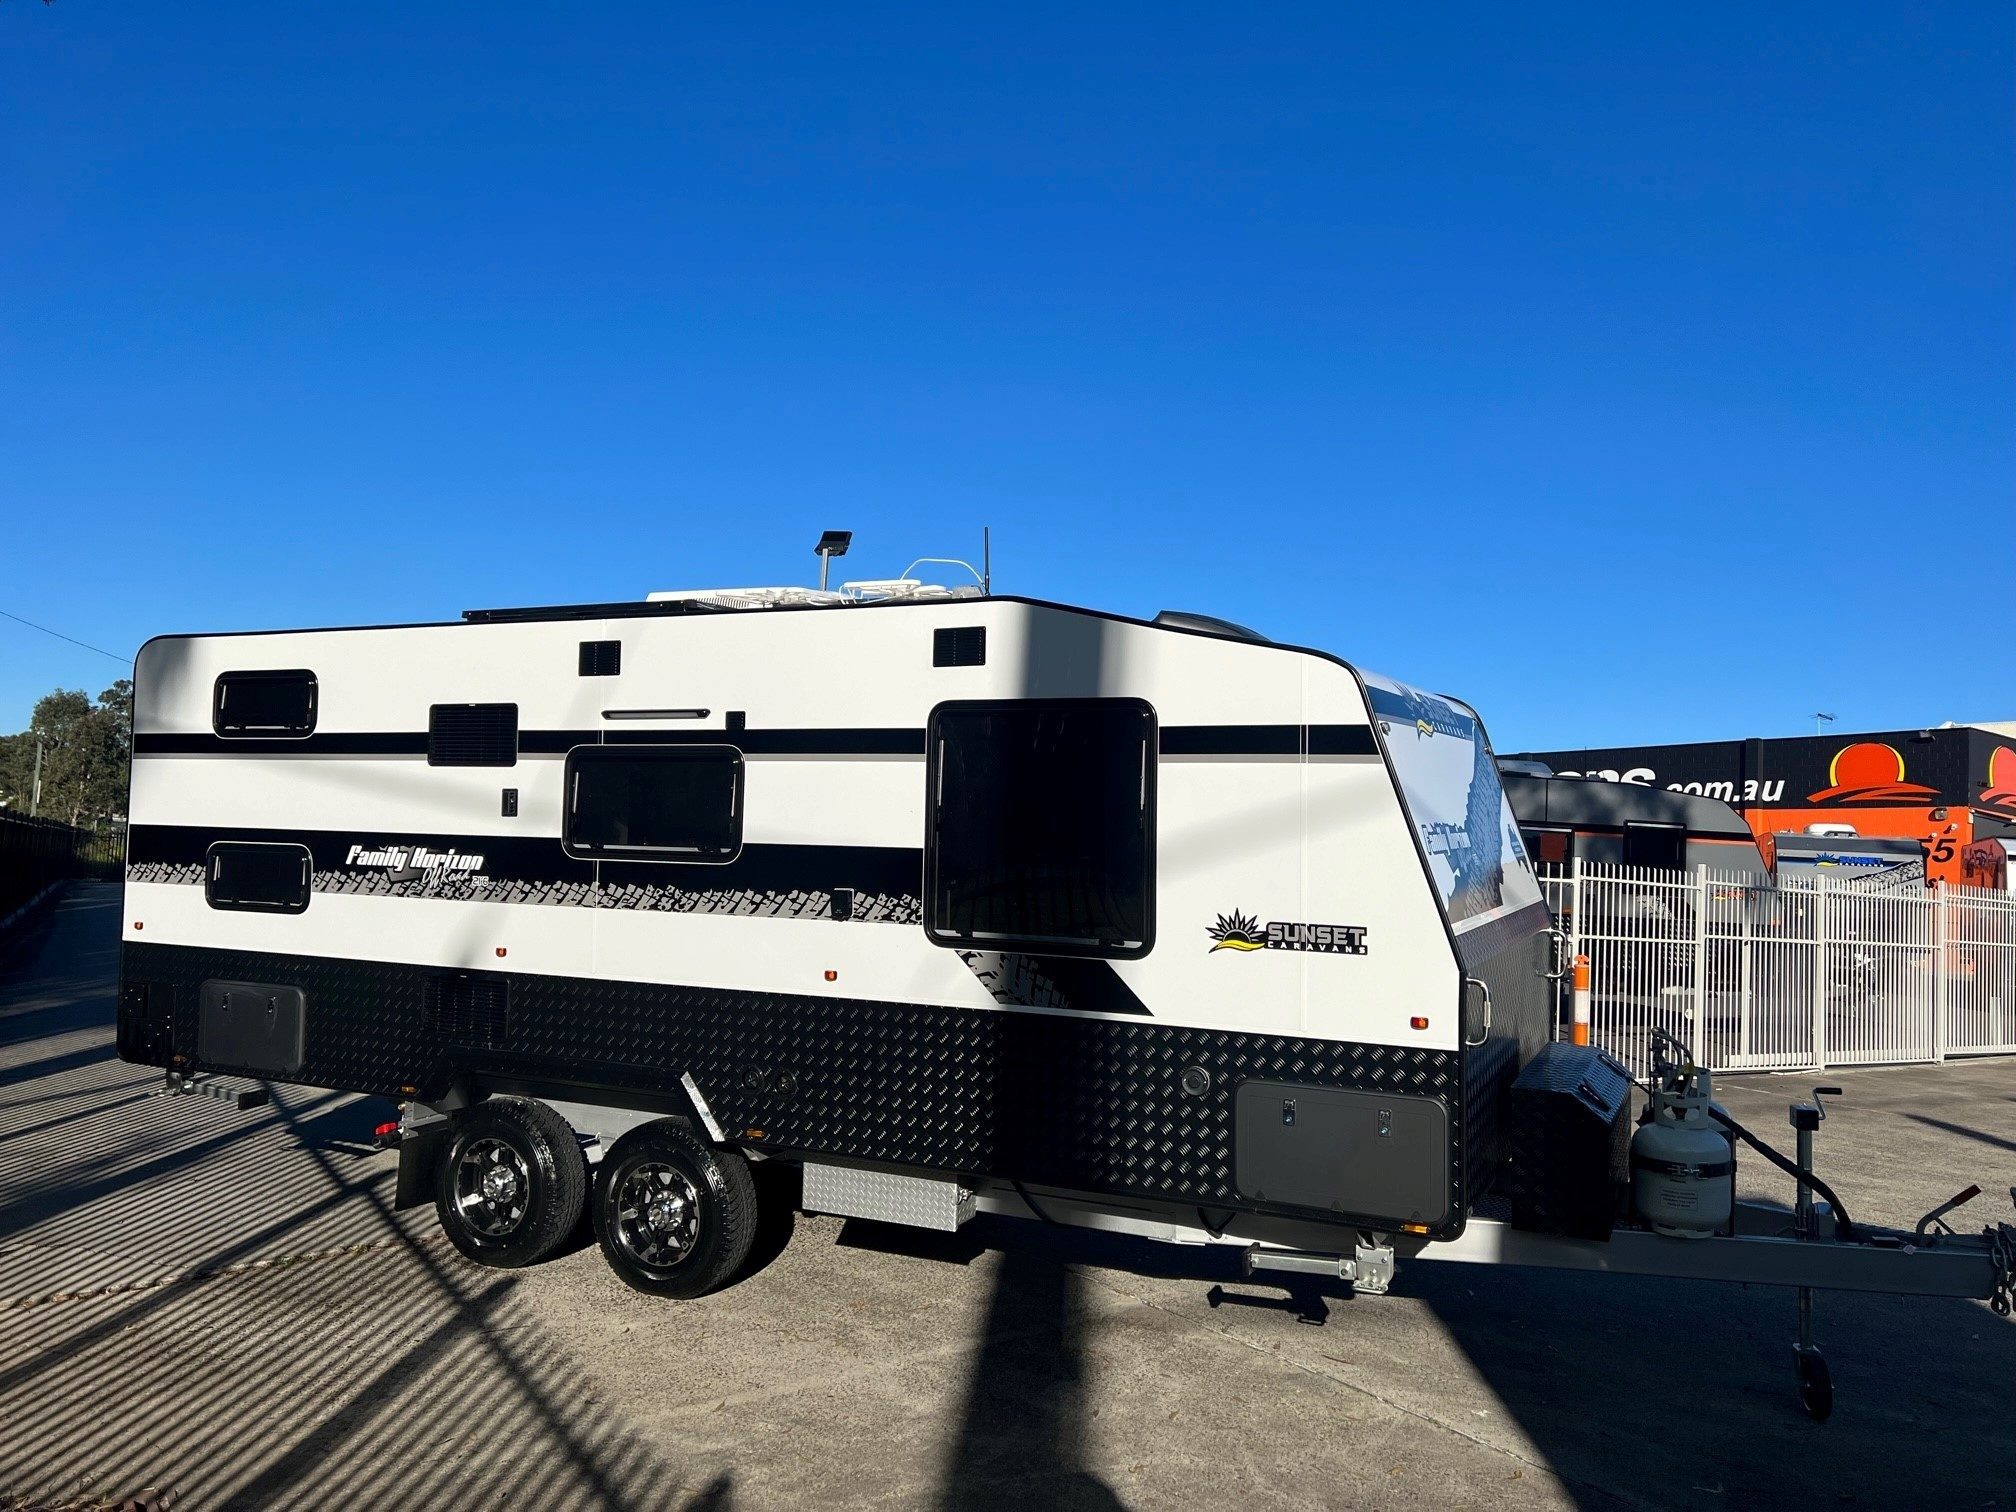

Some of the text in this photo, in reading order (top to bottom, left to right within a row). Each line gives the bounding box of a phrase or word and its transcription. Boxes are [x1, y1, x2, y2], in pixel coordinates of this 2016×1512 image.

[345, 845, 484, 872] Family Horizon
[1266, 922, 1367, 946] SUNSET
[1266, 941, 1367, 954] CARAVANS
